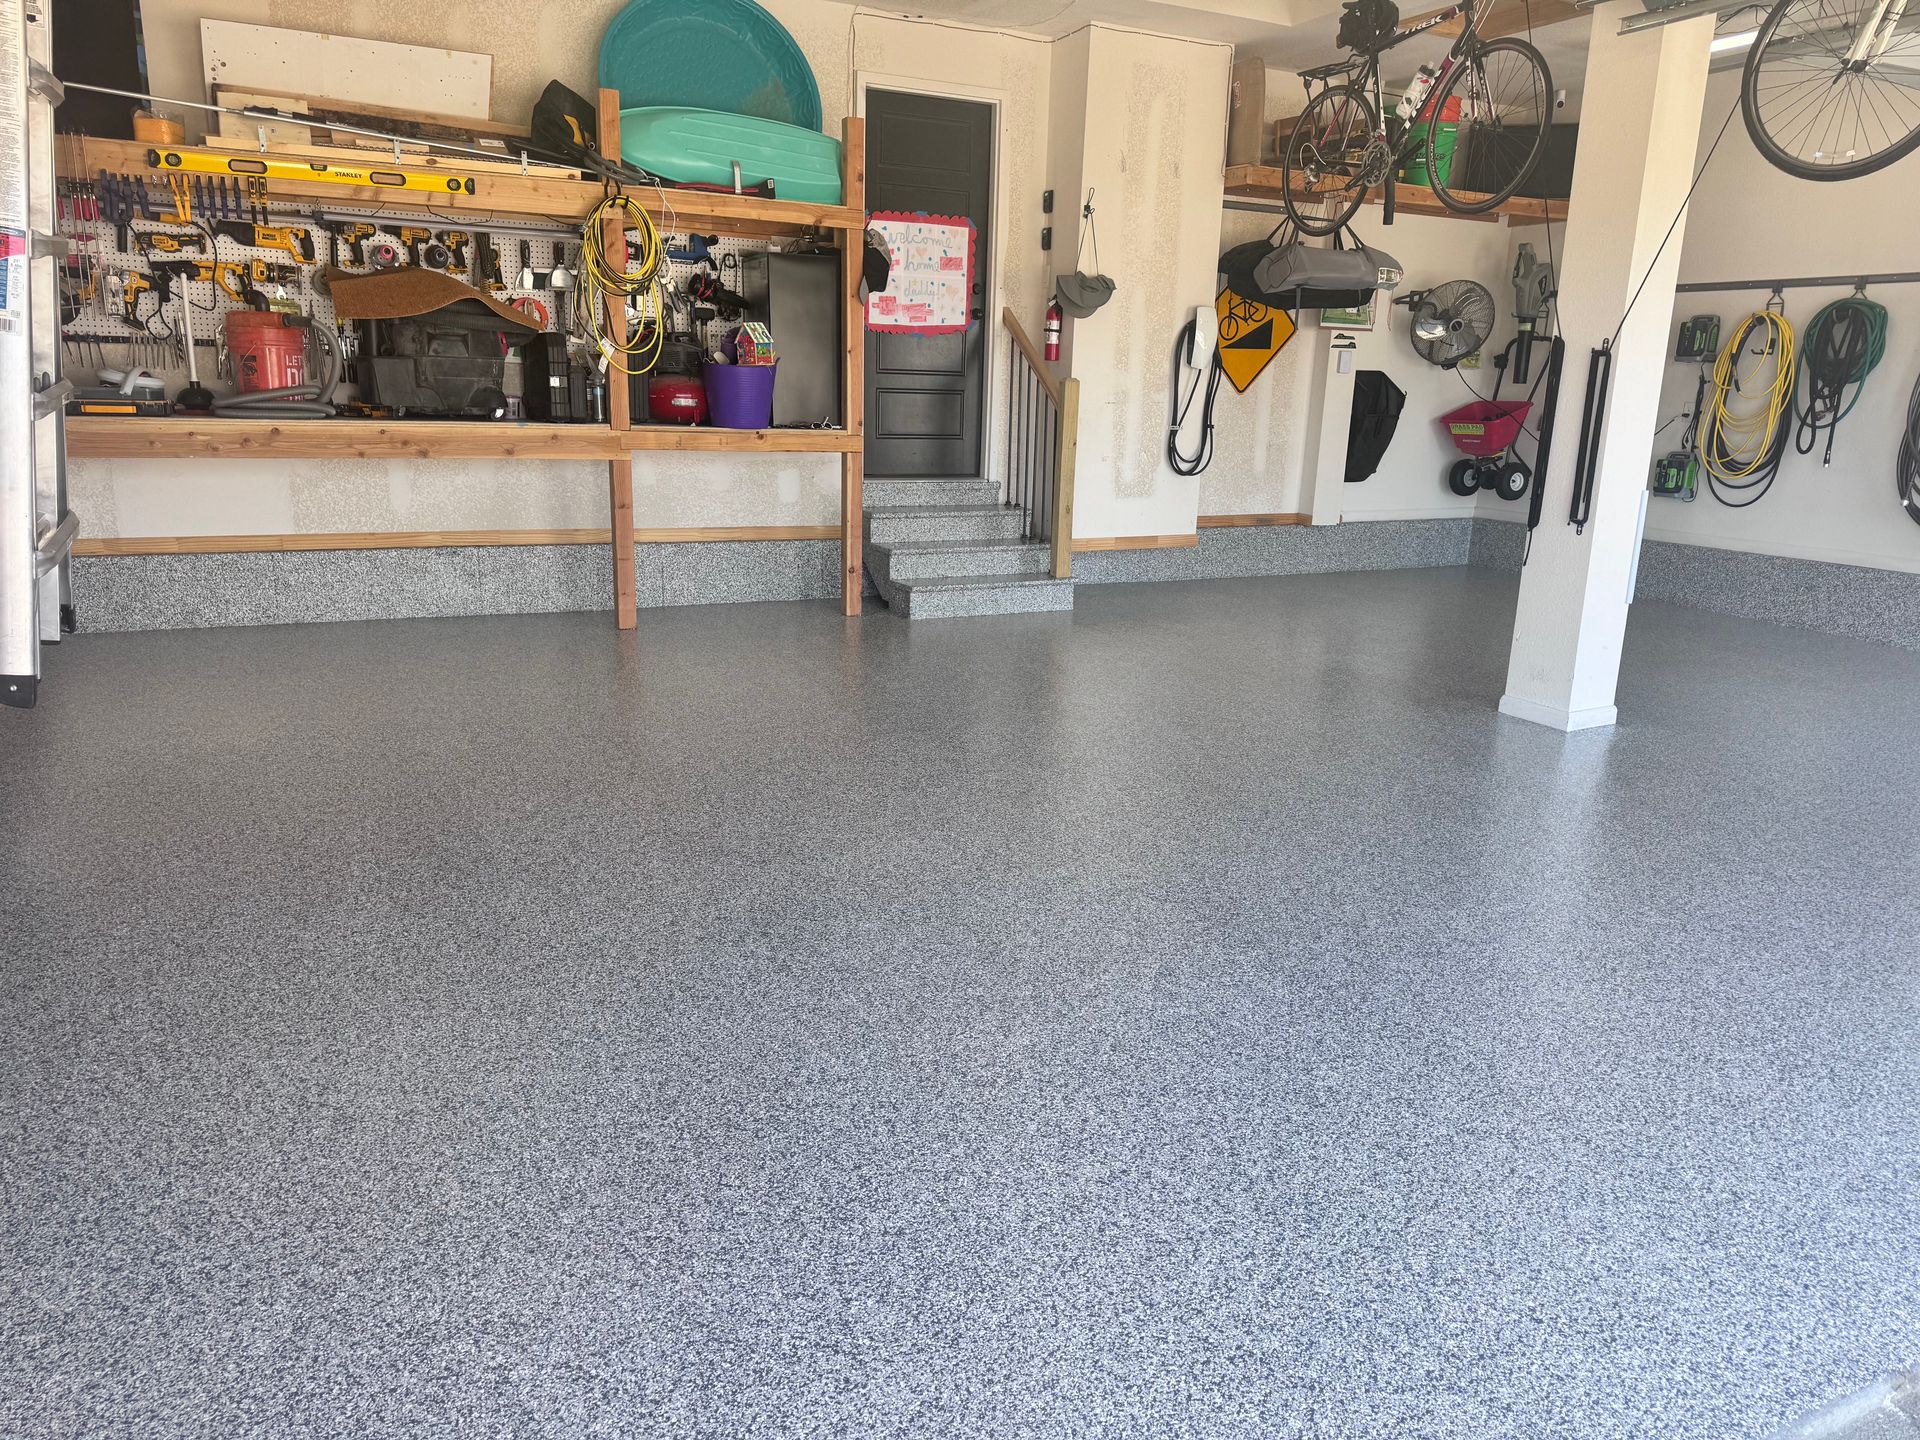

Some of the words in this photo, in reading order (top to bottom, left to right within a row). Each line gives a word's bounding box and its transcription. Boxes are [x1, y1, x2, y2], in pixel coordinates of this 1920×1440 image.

[1404, 14, 1443, 35] TREK
[334, 171, 363, 179] STANLEY
[888, 224, 952, 248] welcome
[904, 247, 940, 272] home
